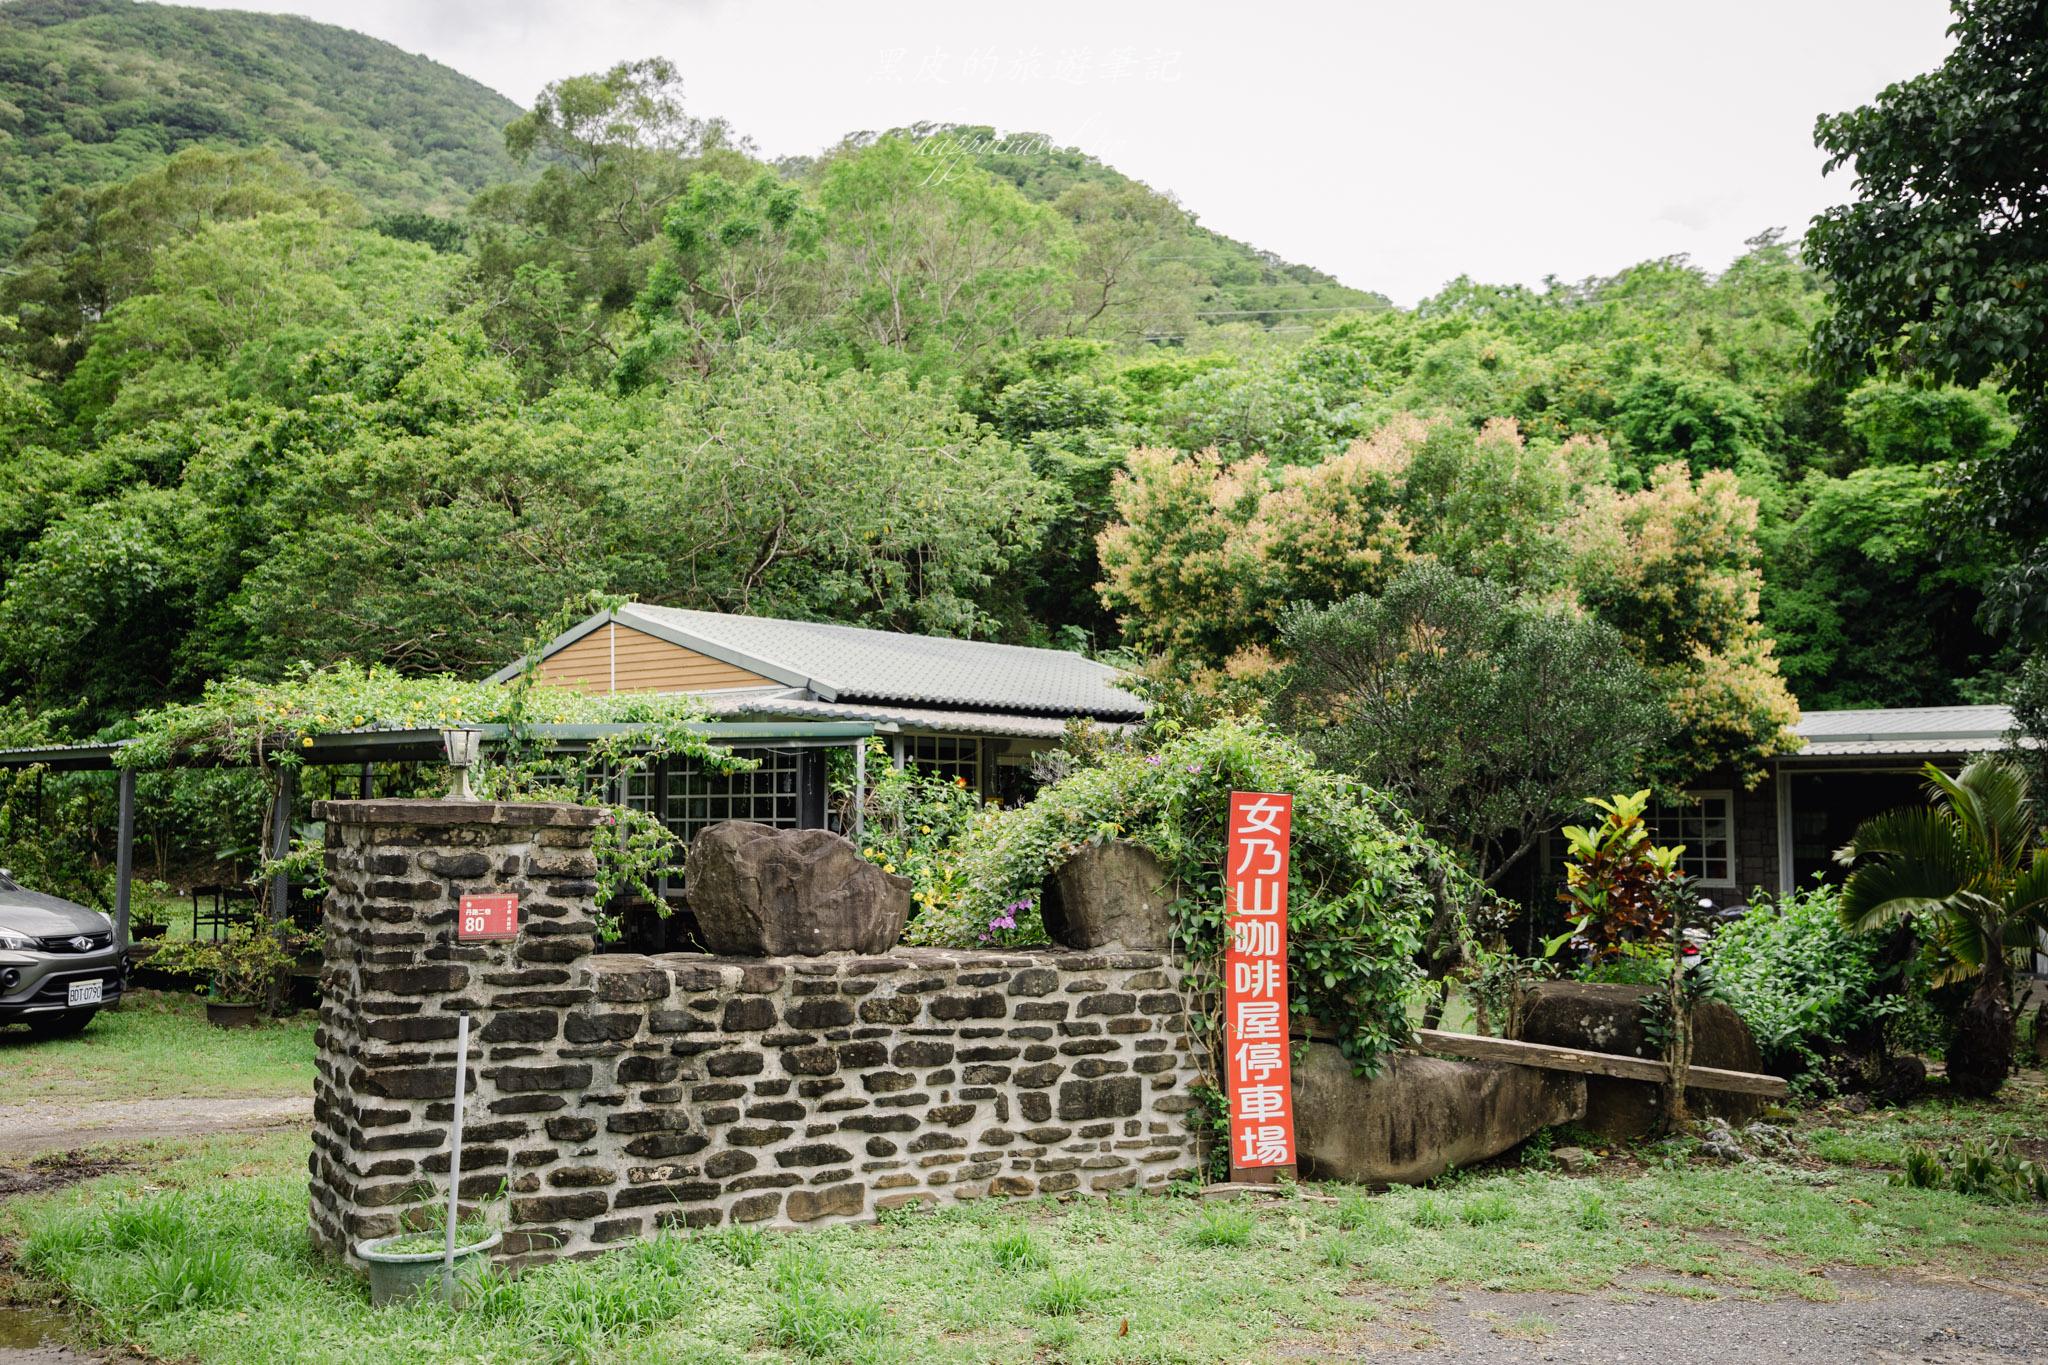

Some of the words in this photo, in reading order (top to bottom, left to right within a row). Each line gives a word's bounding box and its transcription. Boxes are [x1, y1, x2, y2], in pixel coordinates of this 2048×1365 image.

[465, 916, 485, 933] 80
[1235, 797, 1287, 1164] 女乃山咖啡屋停車場
